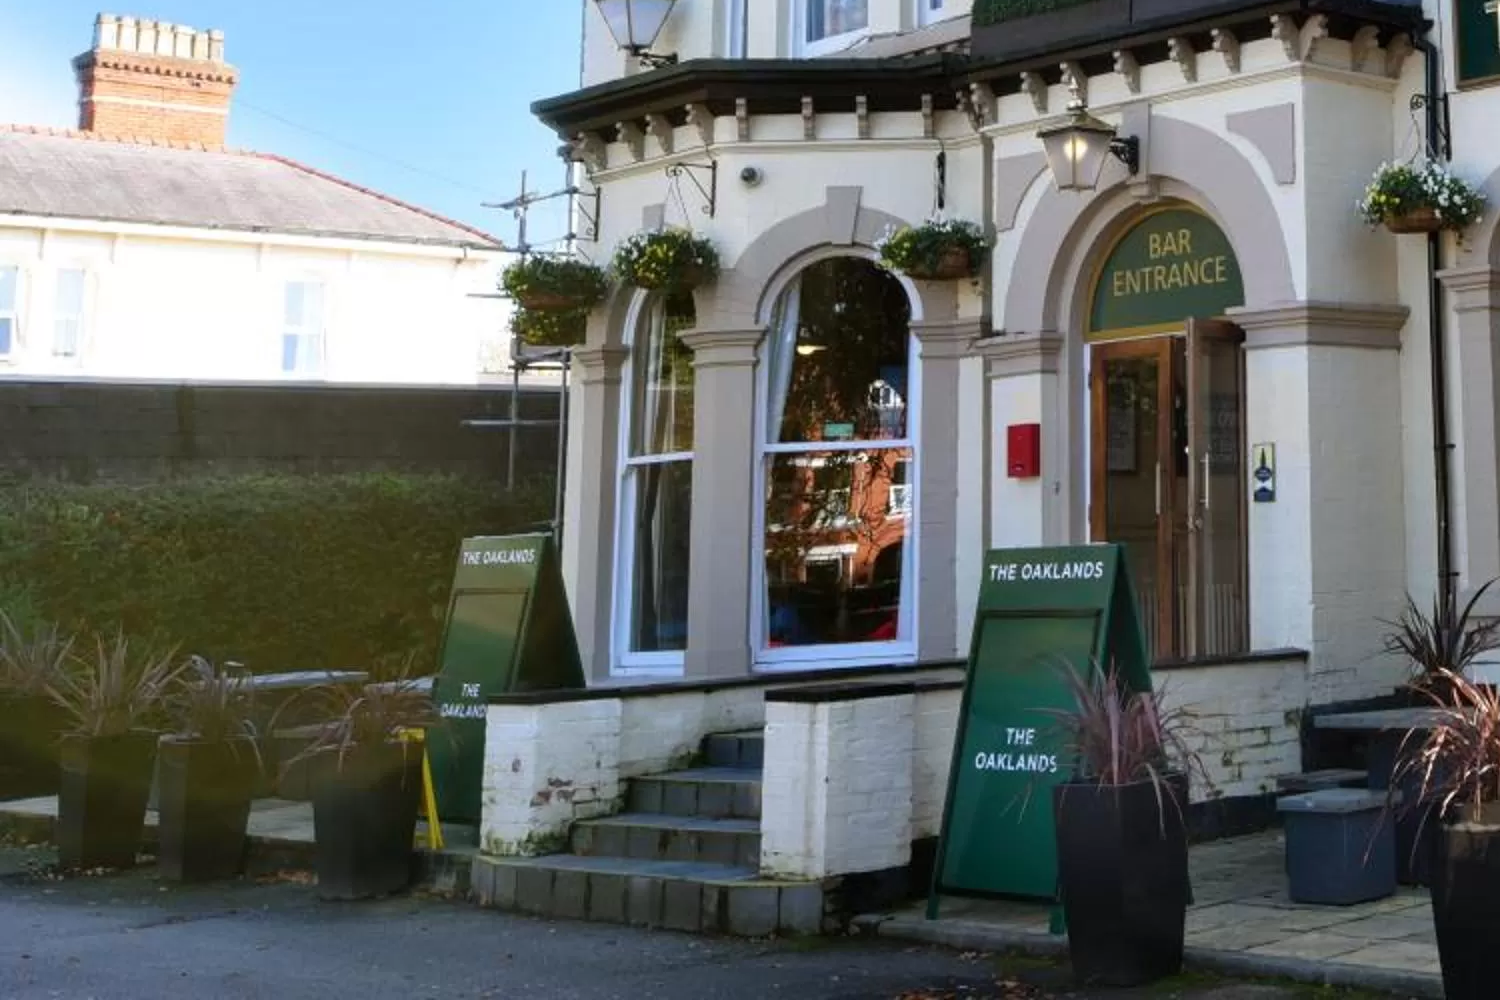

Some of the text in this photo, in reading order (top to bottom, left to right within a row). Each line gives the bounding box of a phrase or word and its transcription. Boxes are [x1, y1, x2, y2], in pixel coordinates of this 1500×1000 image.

[1149, 229, 1191, 258] BAR
[1112, 256, 1227, 296] ENTRANCE
[463, 549, 535, 566] THE OAKLANDS
[989, 561, 1104, 582] THE OAKLANDS
[461, 682, 481, 698] THE
[440, 702, 487, 719] OAKLAND
[1006, 727, 1035, 745] THE
[975, 752, 1057, 773] OAKLANDS
